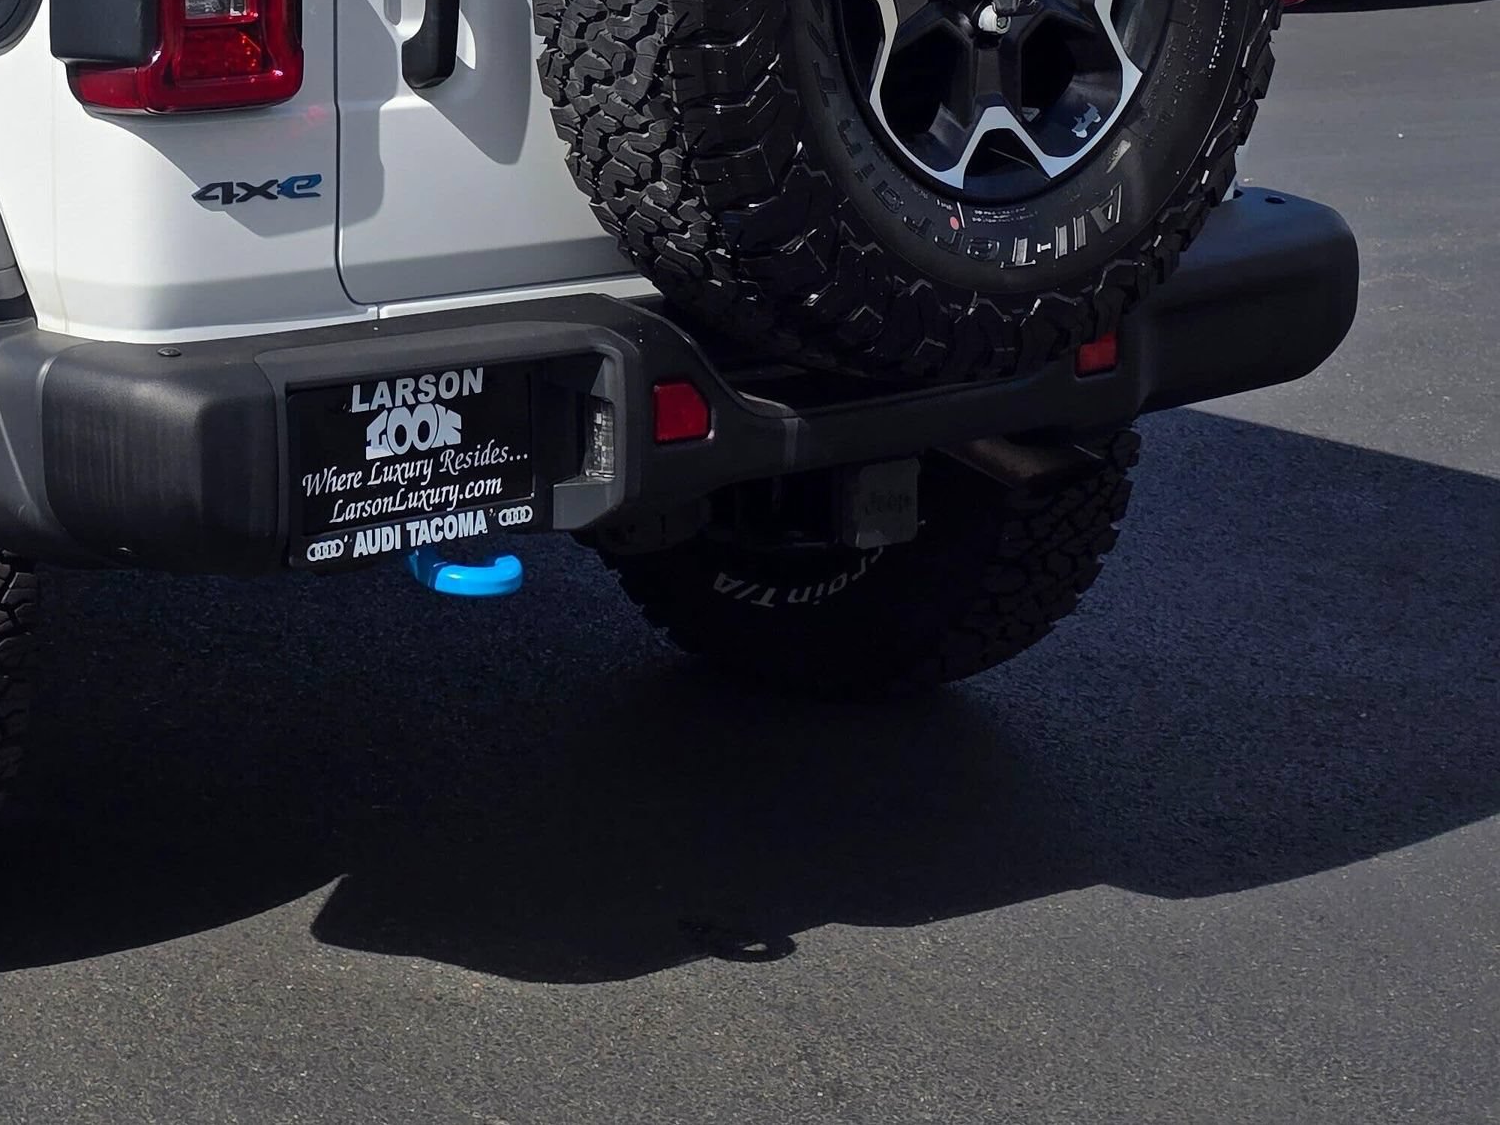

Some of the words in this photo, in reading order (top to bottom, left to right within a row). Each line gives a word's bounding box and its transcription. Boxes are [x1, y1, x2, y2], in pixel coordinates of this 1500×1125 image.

[191, 174, 322, 205] 4xe
[351, 367, 484, 413] LARSON
[302, 466, 363, 497] Where
[367, 457, 434, 486] Luxury
[439, 439, 529, 475] Resides...
[329, 477, 503, 523] LarsonLuxury.com
[352, 525, 402, 557] AUDI
[406, 509, 488, 547] TACOMA
